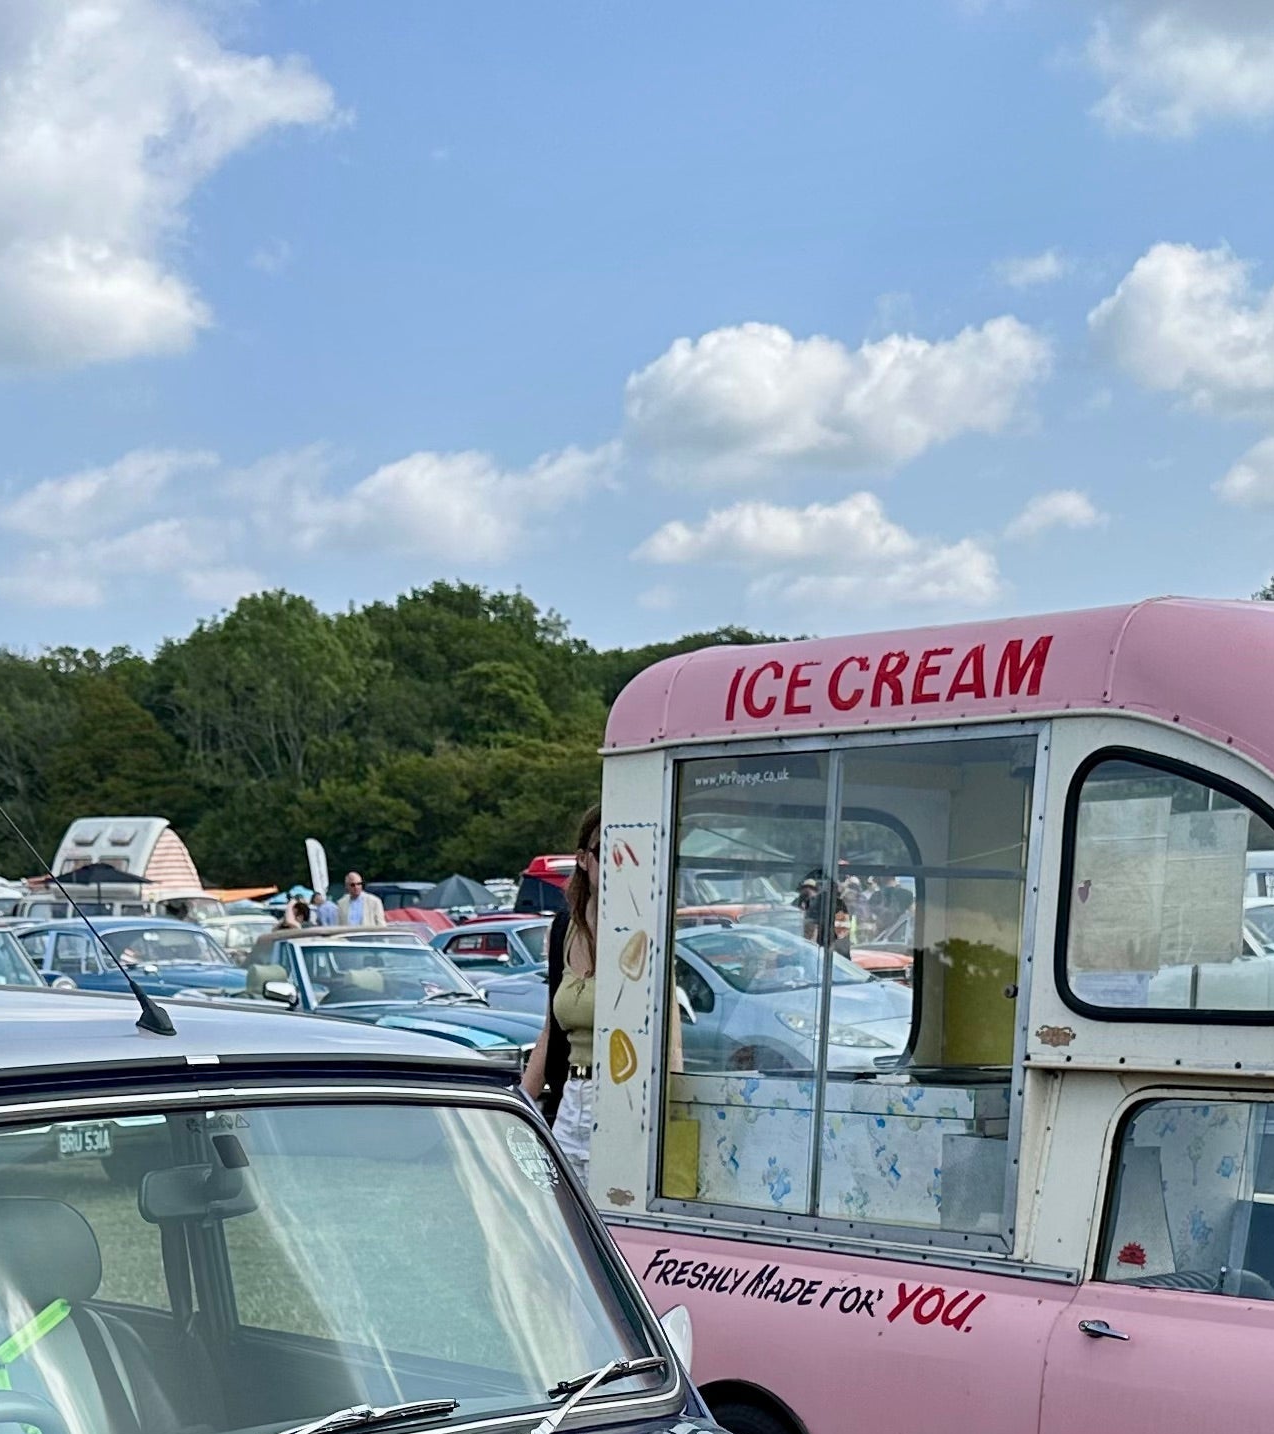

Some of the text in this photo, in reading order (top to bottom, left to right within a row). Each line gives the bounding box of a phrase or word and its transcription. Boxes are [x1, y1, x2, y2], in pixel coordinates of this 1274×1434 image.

[725, 635, 1053, 721] ICE CREAM
[59, 1132, 83, 1153] BRU
[642, 1248, 750, 1296] FRESHLY
[742, 1263, 823, 1306] MADE
[887, 1282, 987, 1333] YOU.
